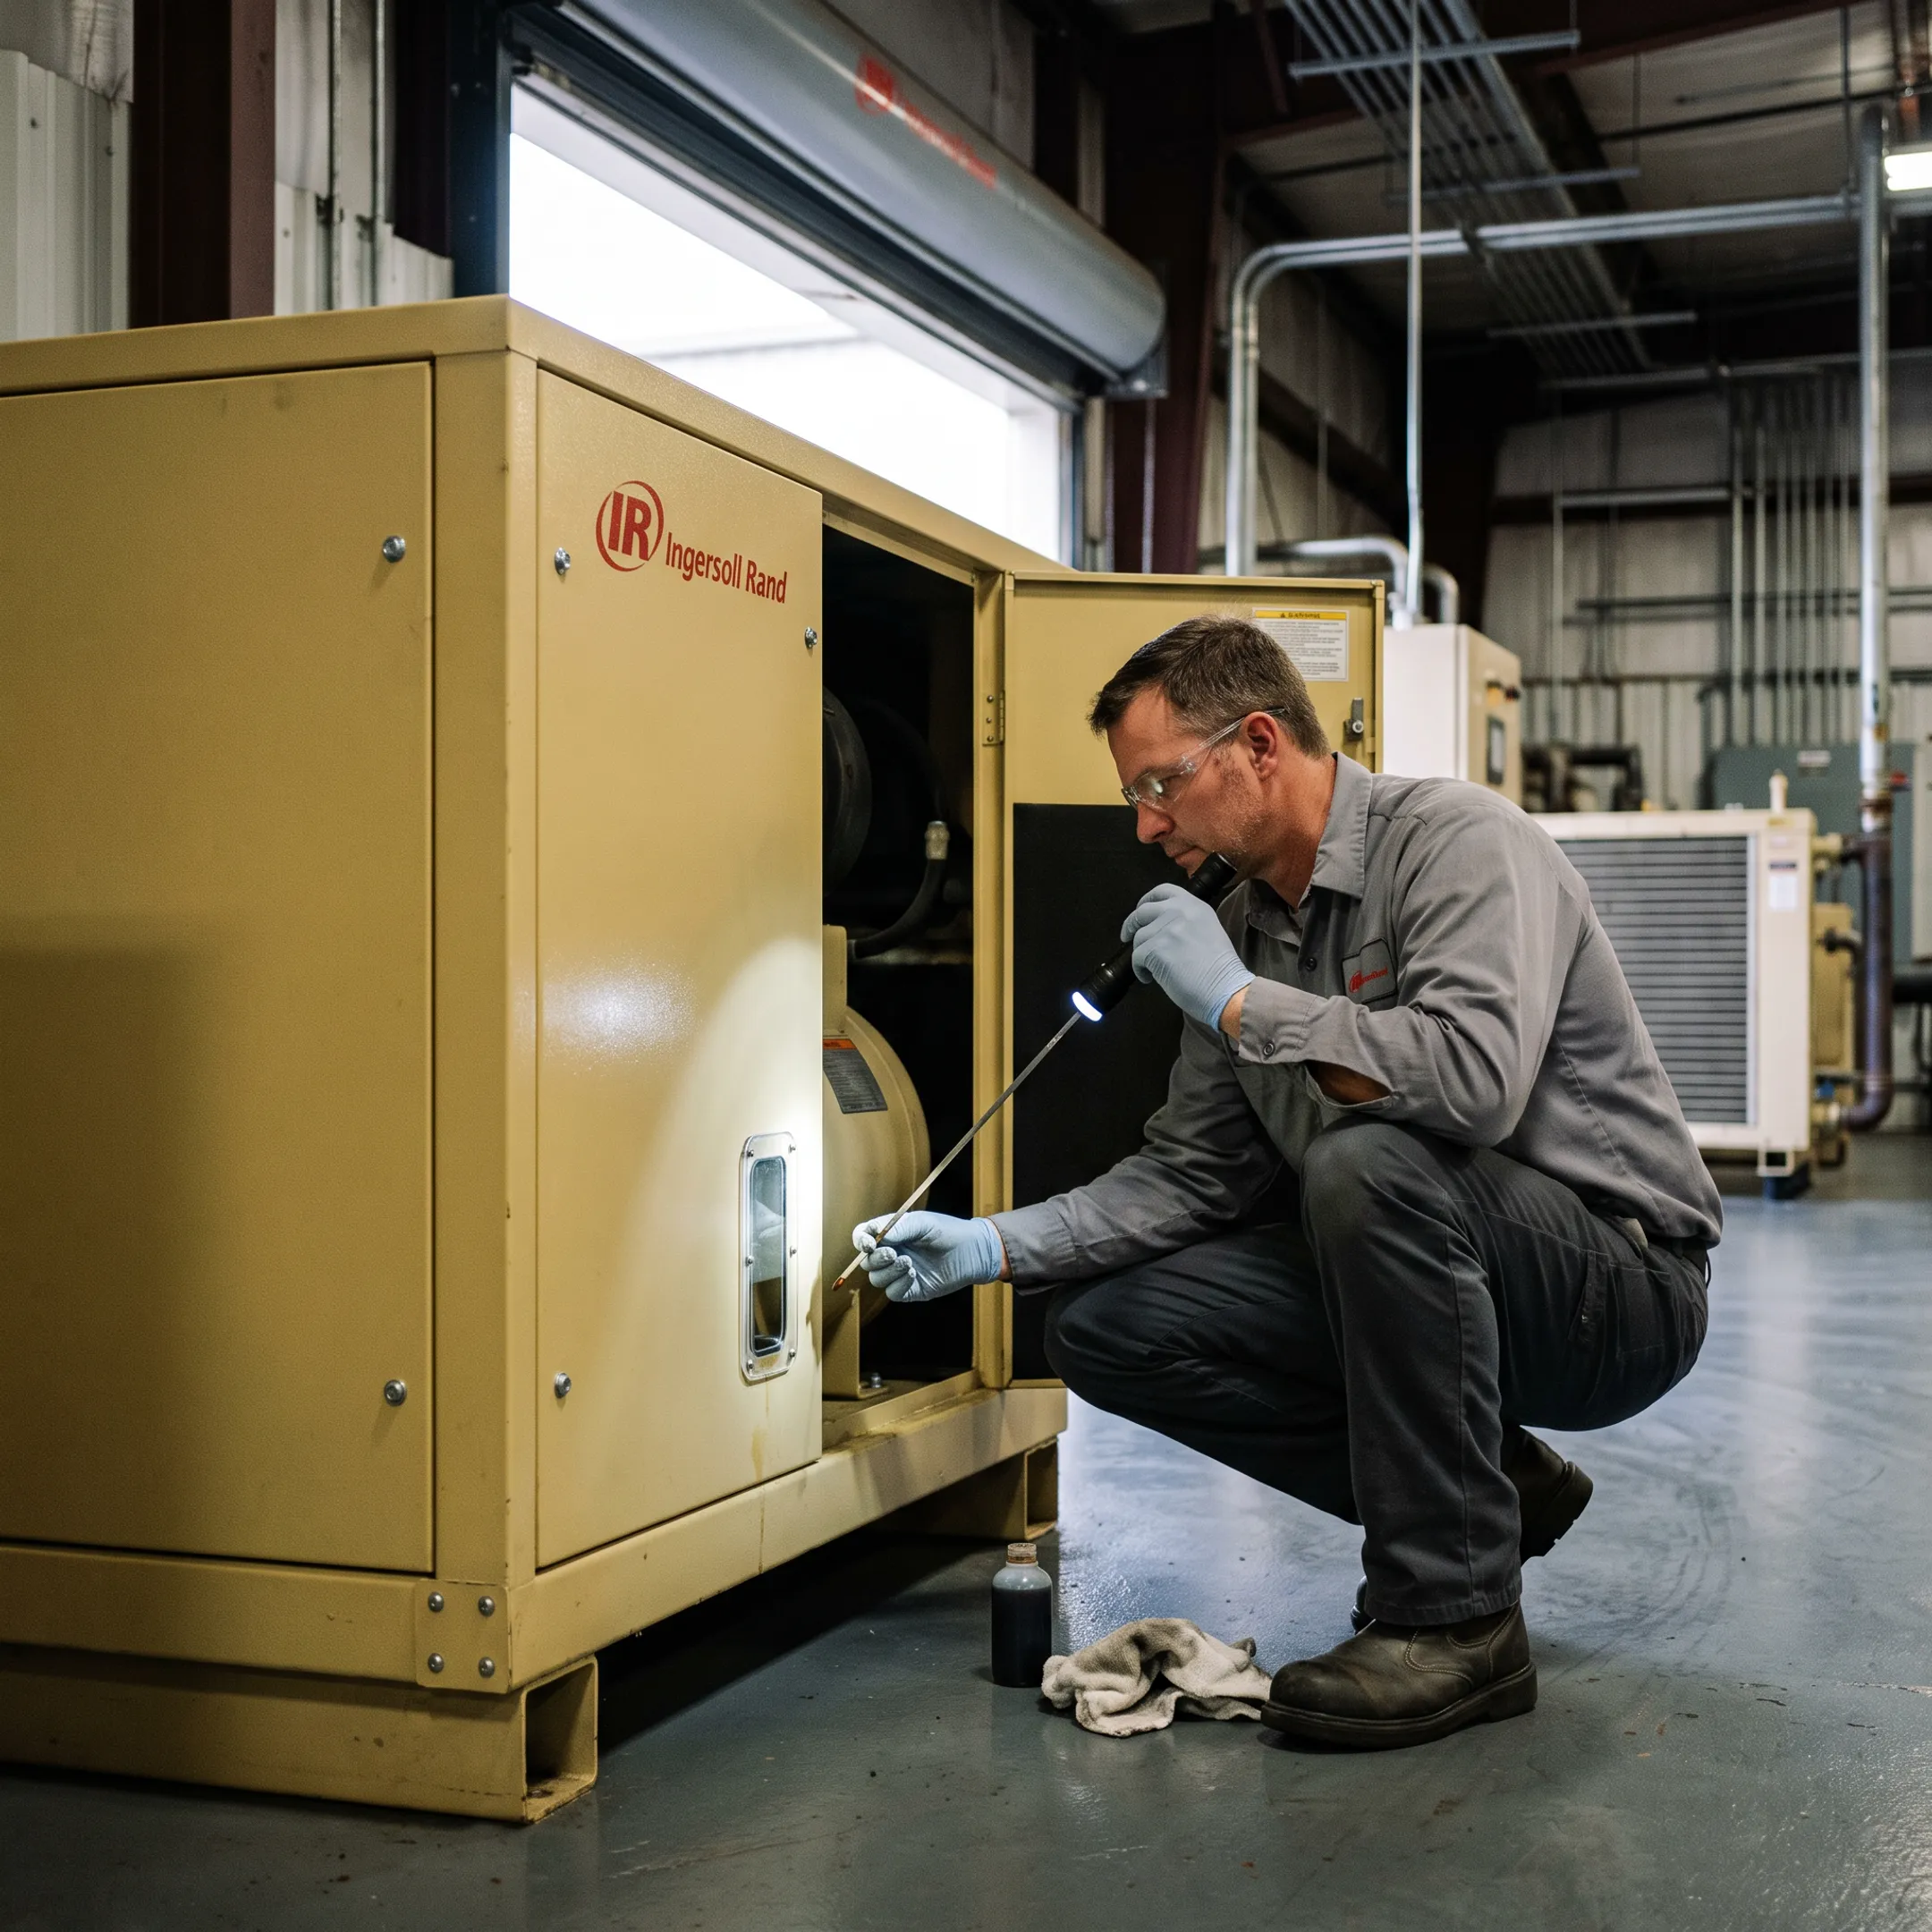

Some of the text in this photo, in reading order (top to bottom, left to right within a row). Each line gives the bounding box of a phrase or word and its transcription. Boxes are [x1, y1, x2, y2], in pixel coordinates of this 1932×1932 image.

[608, 490, 649, 561] IR
[665, 532, 787, 604] Ingersoll Rand
